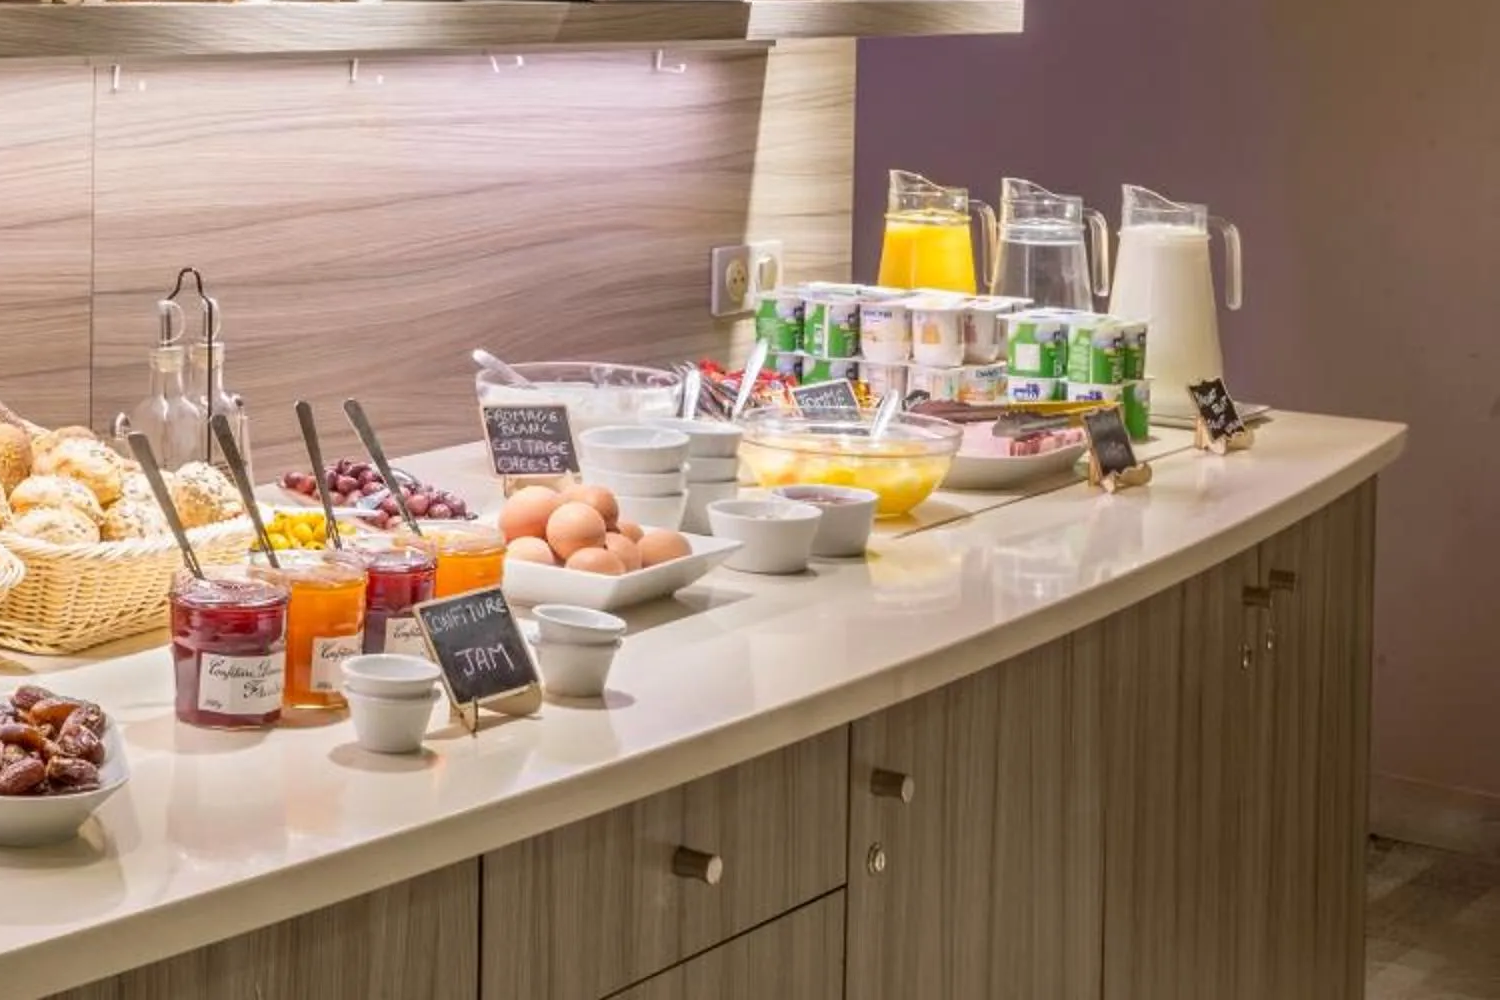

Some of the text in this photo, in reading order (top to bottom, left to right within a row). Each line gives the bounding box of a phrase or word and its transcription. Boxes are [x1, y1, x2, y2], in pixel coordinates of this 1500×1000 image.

[497, 421, 554, 437] BLANC
[491, 439, 570, 455] COTTAGE
[497, 455, 565, 472] CHEESE
[422, 596, 509, 634] CONFITURE
[454, 643, 515, 677] JAM
